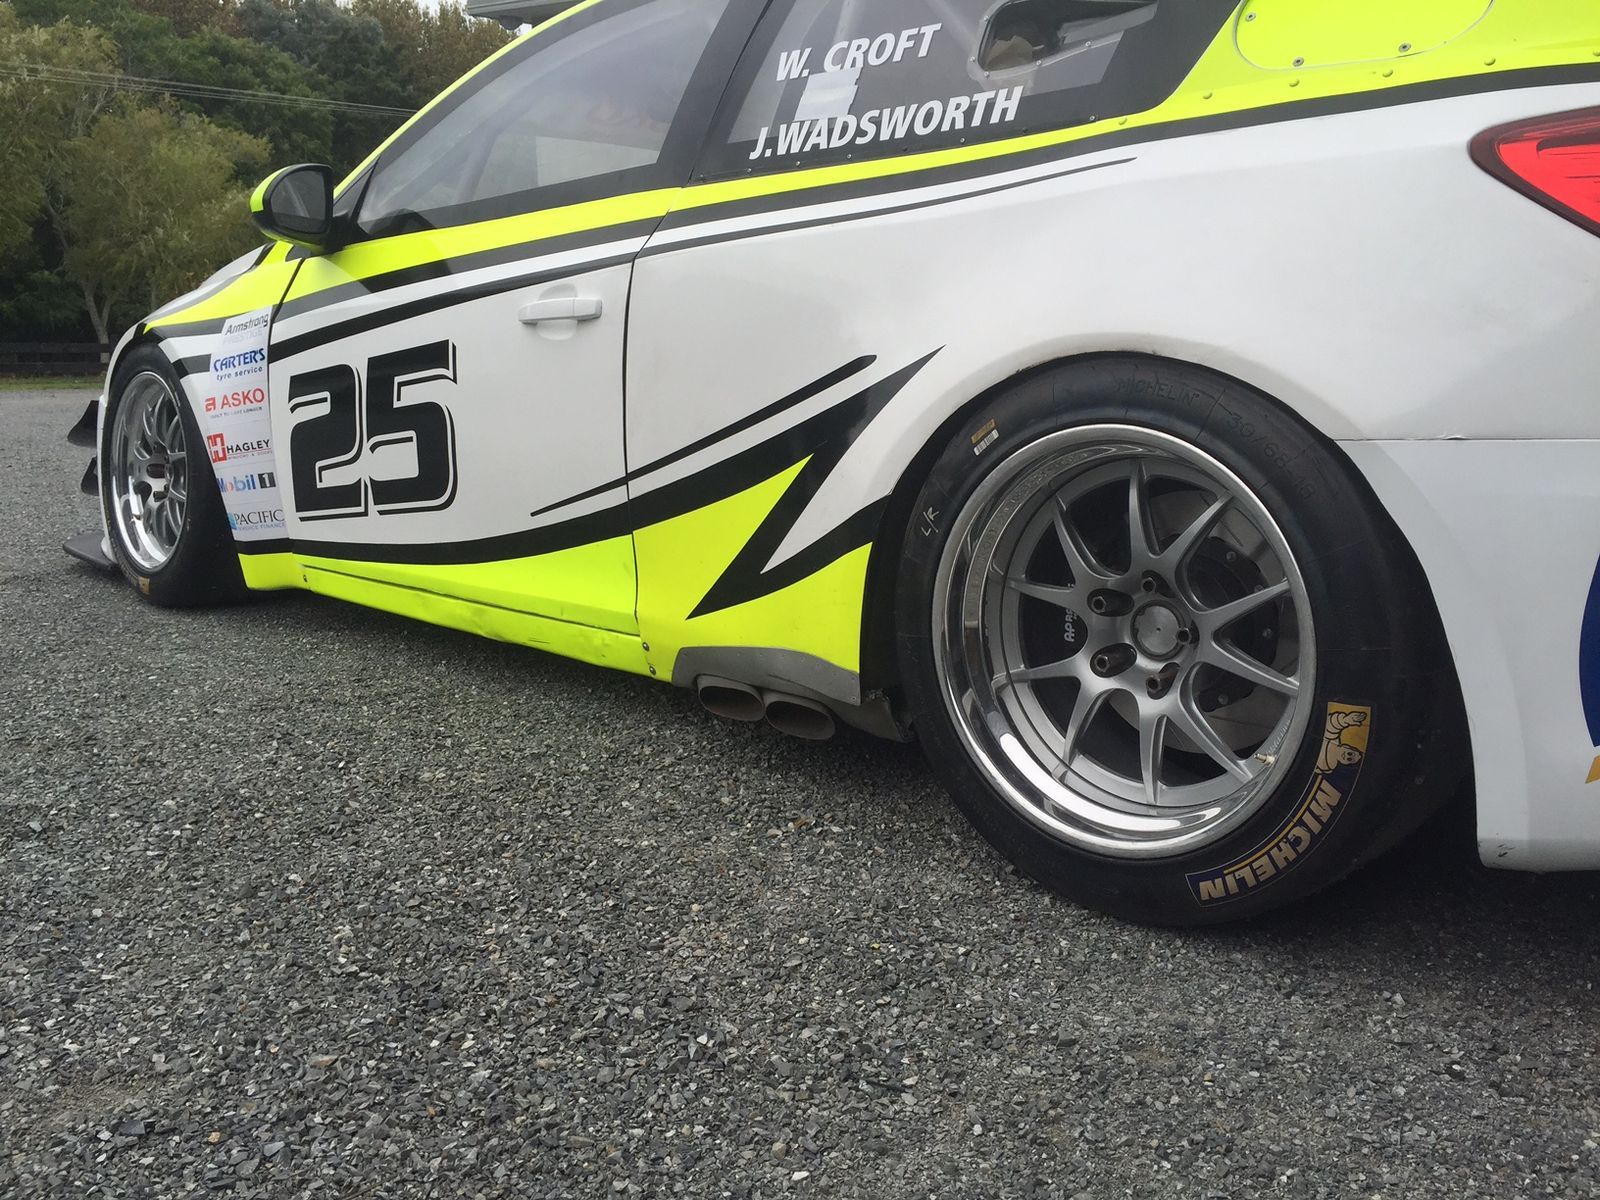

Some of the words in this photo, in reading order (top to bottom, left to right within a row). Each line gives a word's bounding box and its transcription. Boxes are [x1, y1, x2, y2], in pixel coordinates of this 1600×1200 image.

[776, 47, 812, 82] W.
[823, 23, 942, 73] CROFT
[749, 85, 1024, 160] J.WADSWORTH
[225, 313, 269, 336] Armstrong
[213, 347, 266, 373] CARTER'S
[216, 372, 232, 382] tyre
[234, 366, 263, 377] service
[220, 387, 265, 410] ASKO
[288, 338, 459, 523] 25
[226, 439, 270, 454] HAGLEY
[216, 474, 256, 493] Mobil
[233, 509, 286, 526] PACIFIC
[1199, 778, 1343, 901] MICHELIN
